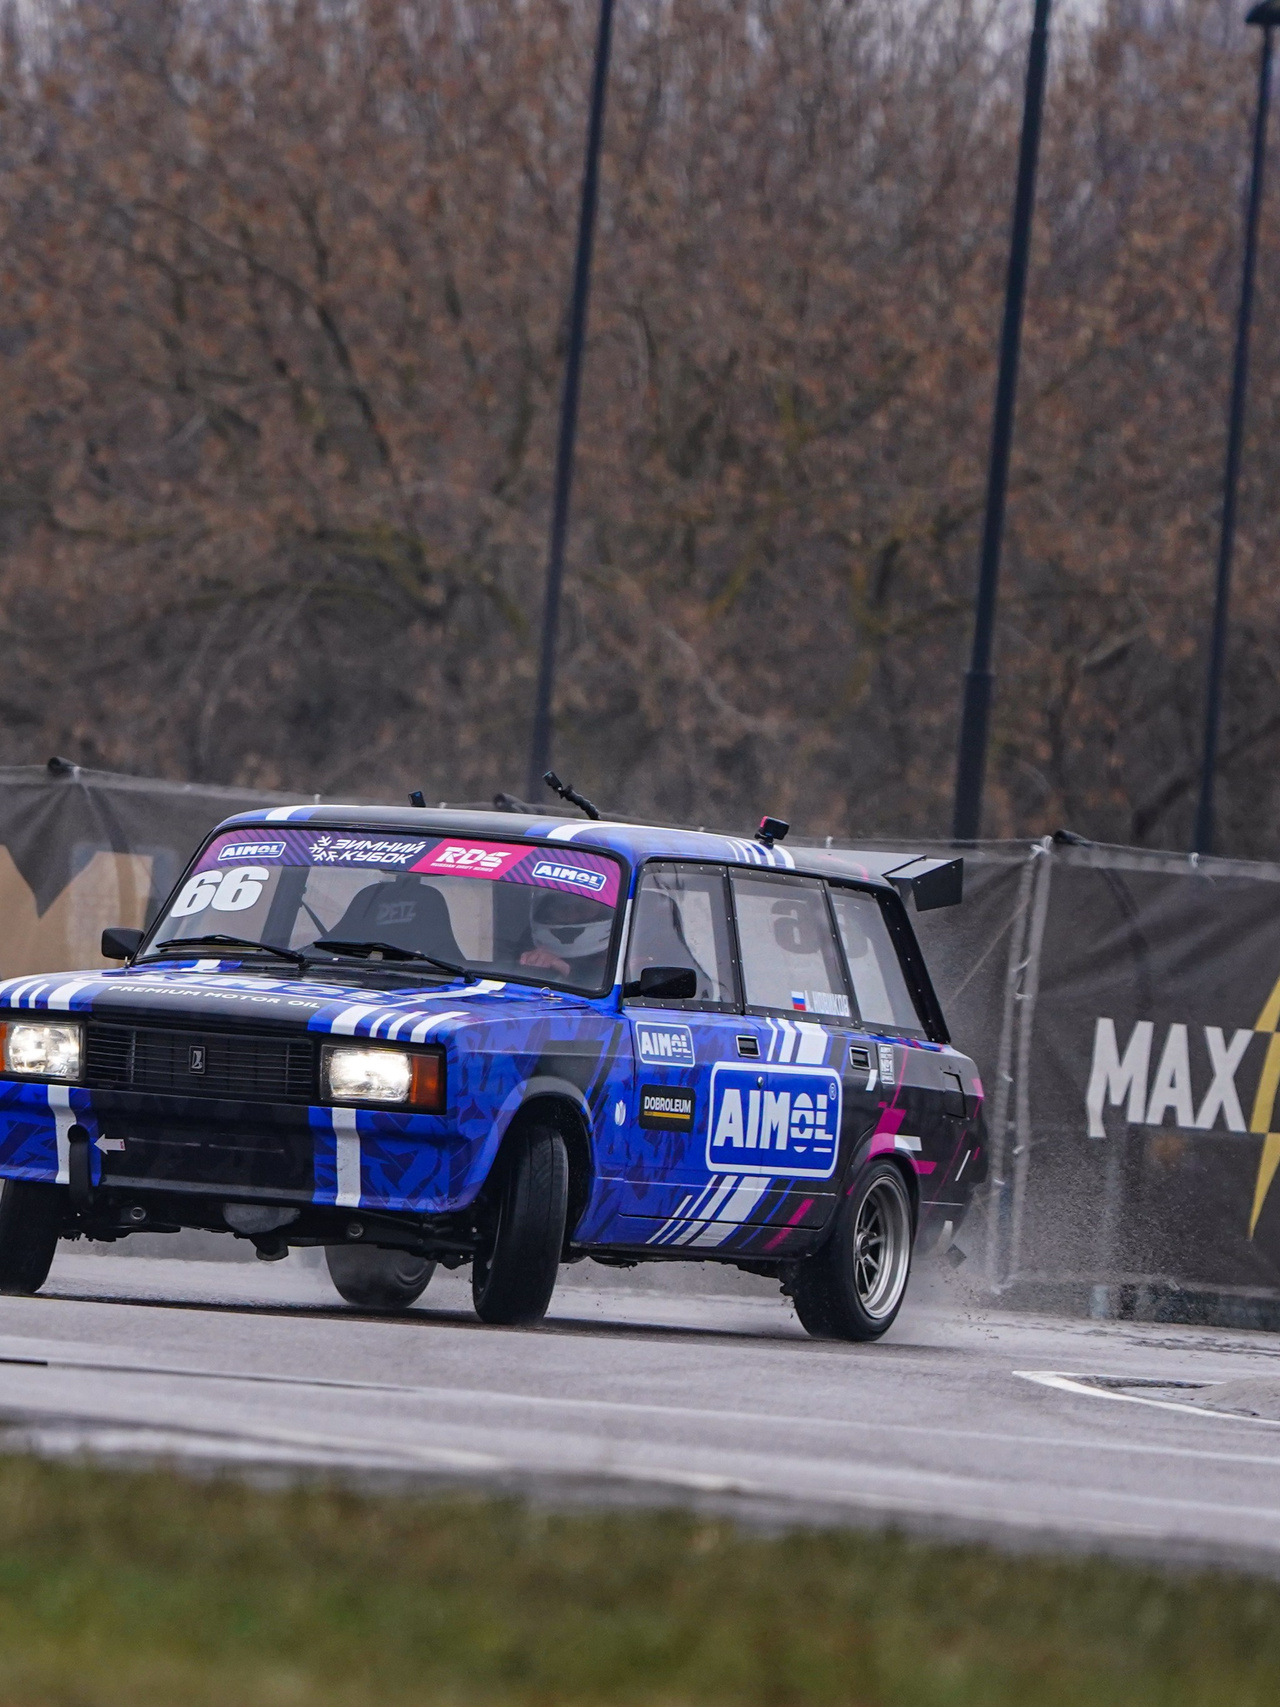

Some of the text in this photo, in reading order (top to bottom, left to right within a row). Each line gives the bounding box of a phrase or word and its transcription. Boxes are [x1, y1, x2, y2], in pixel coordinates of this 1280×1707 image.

[220, 844, 280, 859] AIMOL
[330, 838, 427, 854] ЗИМНИЙ
[338, 851, 414, 864] КУБОК
[436, 846, 512, 867] RDS
[536, 864, 600, 887] AIMOL
[170, 866, 270, 918] 66
[108, 985, 320, 1009] PREMIUM MOTOR OIL
[641, 1031, 692, 1059] AIMOL
[1086, 1016, 1254, 1139] MAX
[644, 1095, 692, 1113] DOBROLEUM
[712, 1089, 834, 1154] AIMOL
